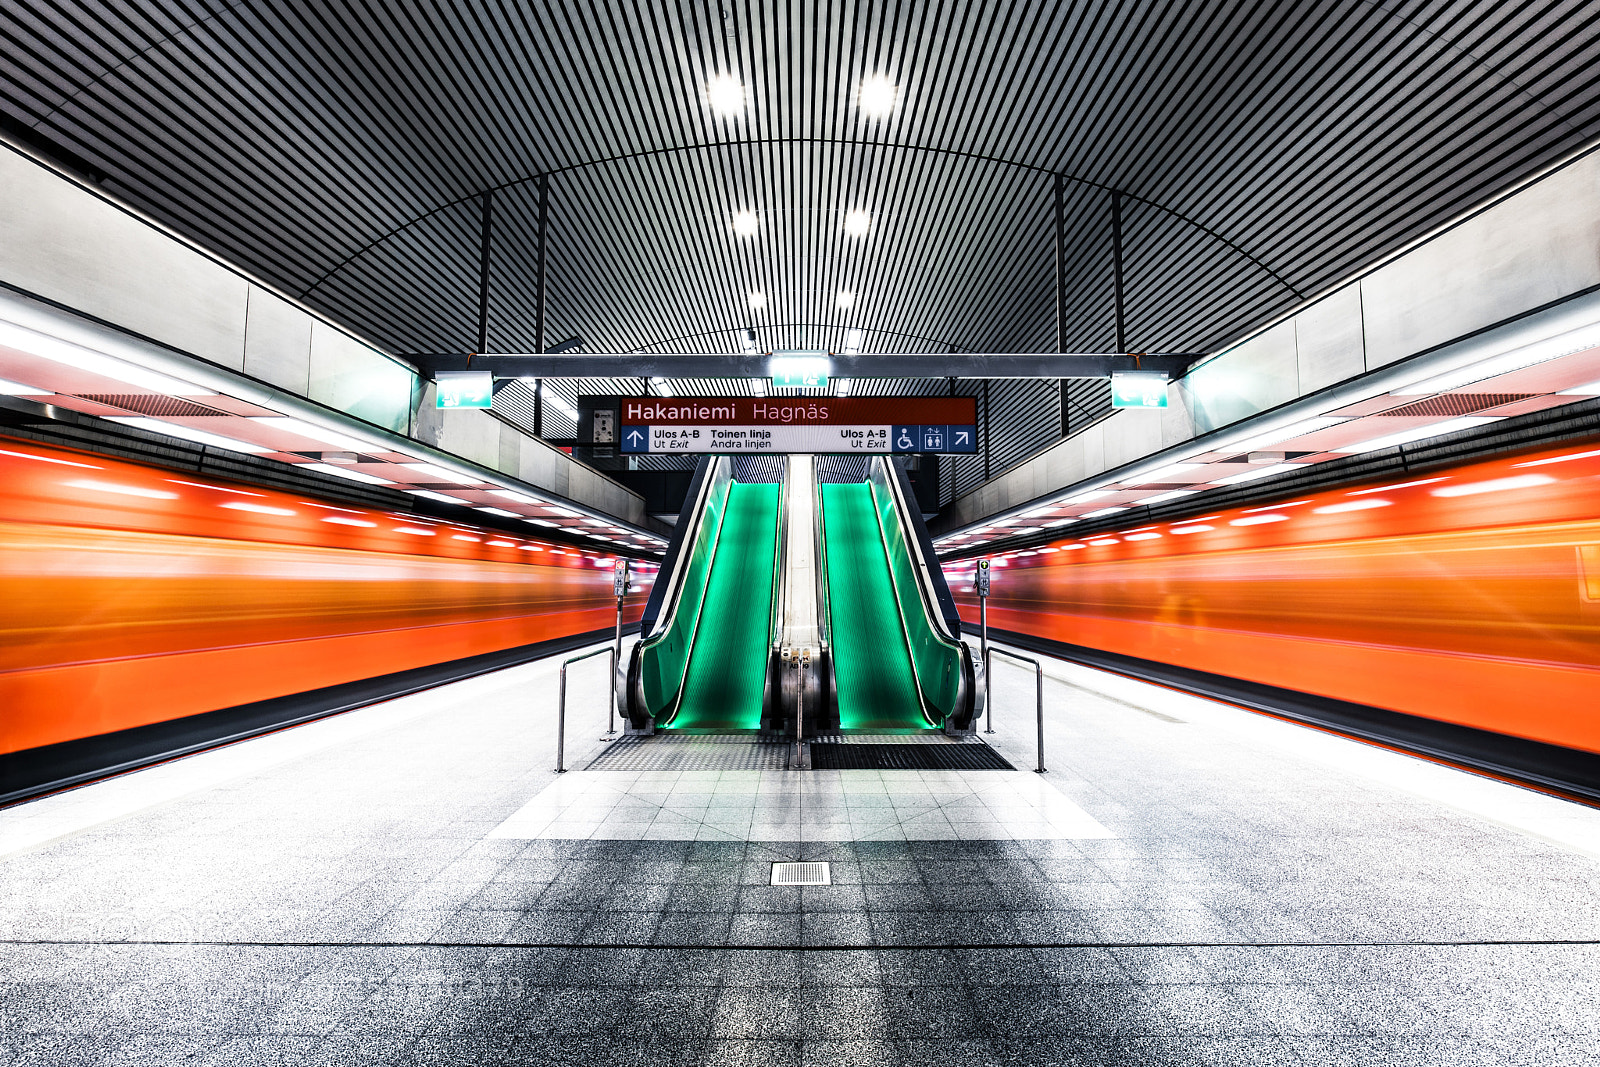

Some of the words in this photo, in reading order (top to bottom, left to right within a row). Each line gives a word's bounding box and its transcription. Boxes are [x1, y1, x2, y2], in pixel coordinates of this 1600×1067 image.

[627, 403, 736, 420] Hakaniemi
[753, 403, 829, 423] Hagnäs
[654, 429, 678, 439] Ulos
[680, 429, 700, 439] A-B
[710, 429, 747, 439] Toinen
[749, 429, 772, 442] linja
[840, 429, 864, 439] Ulos
[866, 429, 887, 439] A-B
[653, 440, 666, 449] Ut
[669, 440, 690, 449] Exit
[710, 440, 742, 449] Andra
[744, 439, 772, 450] linjen
[851, 440, 863, 449] Ut
[866, 440, 887, 449] Exit
